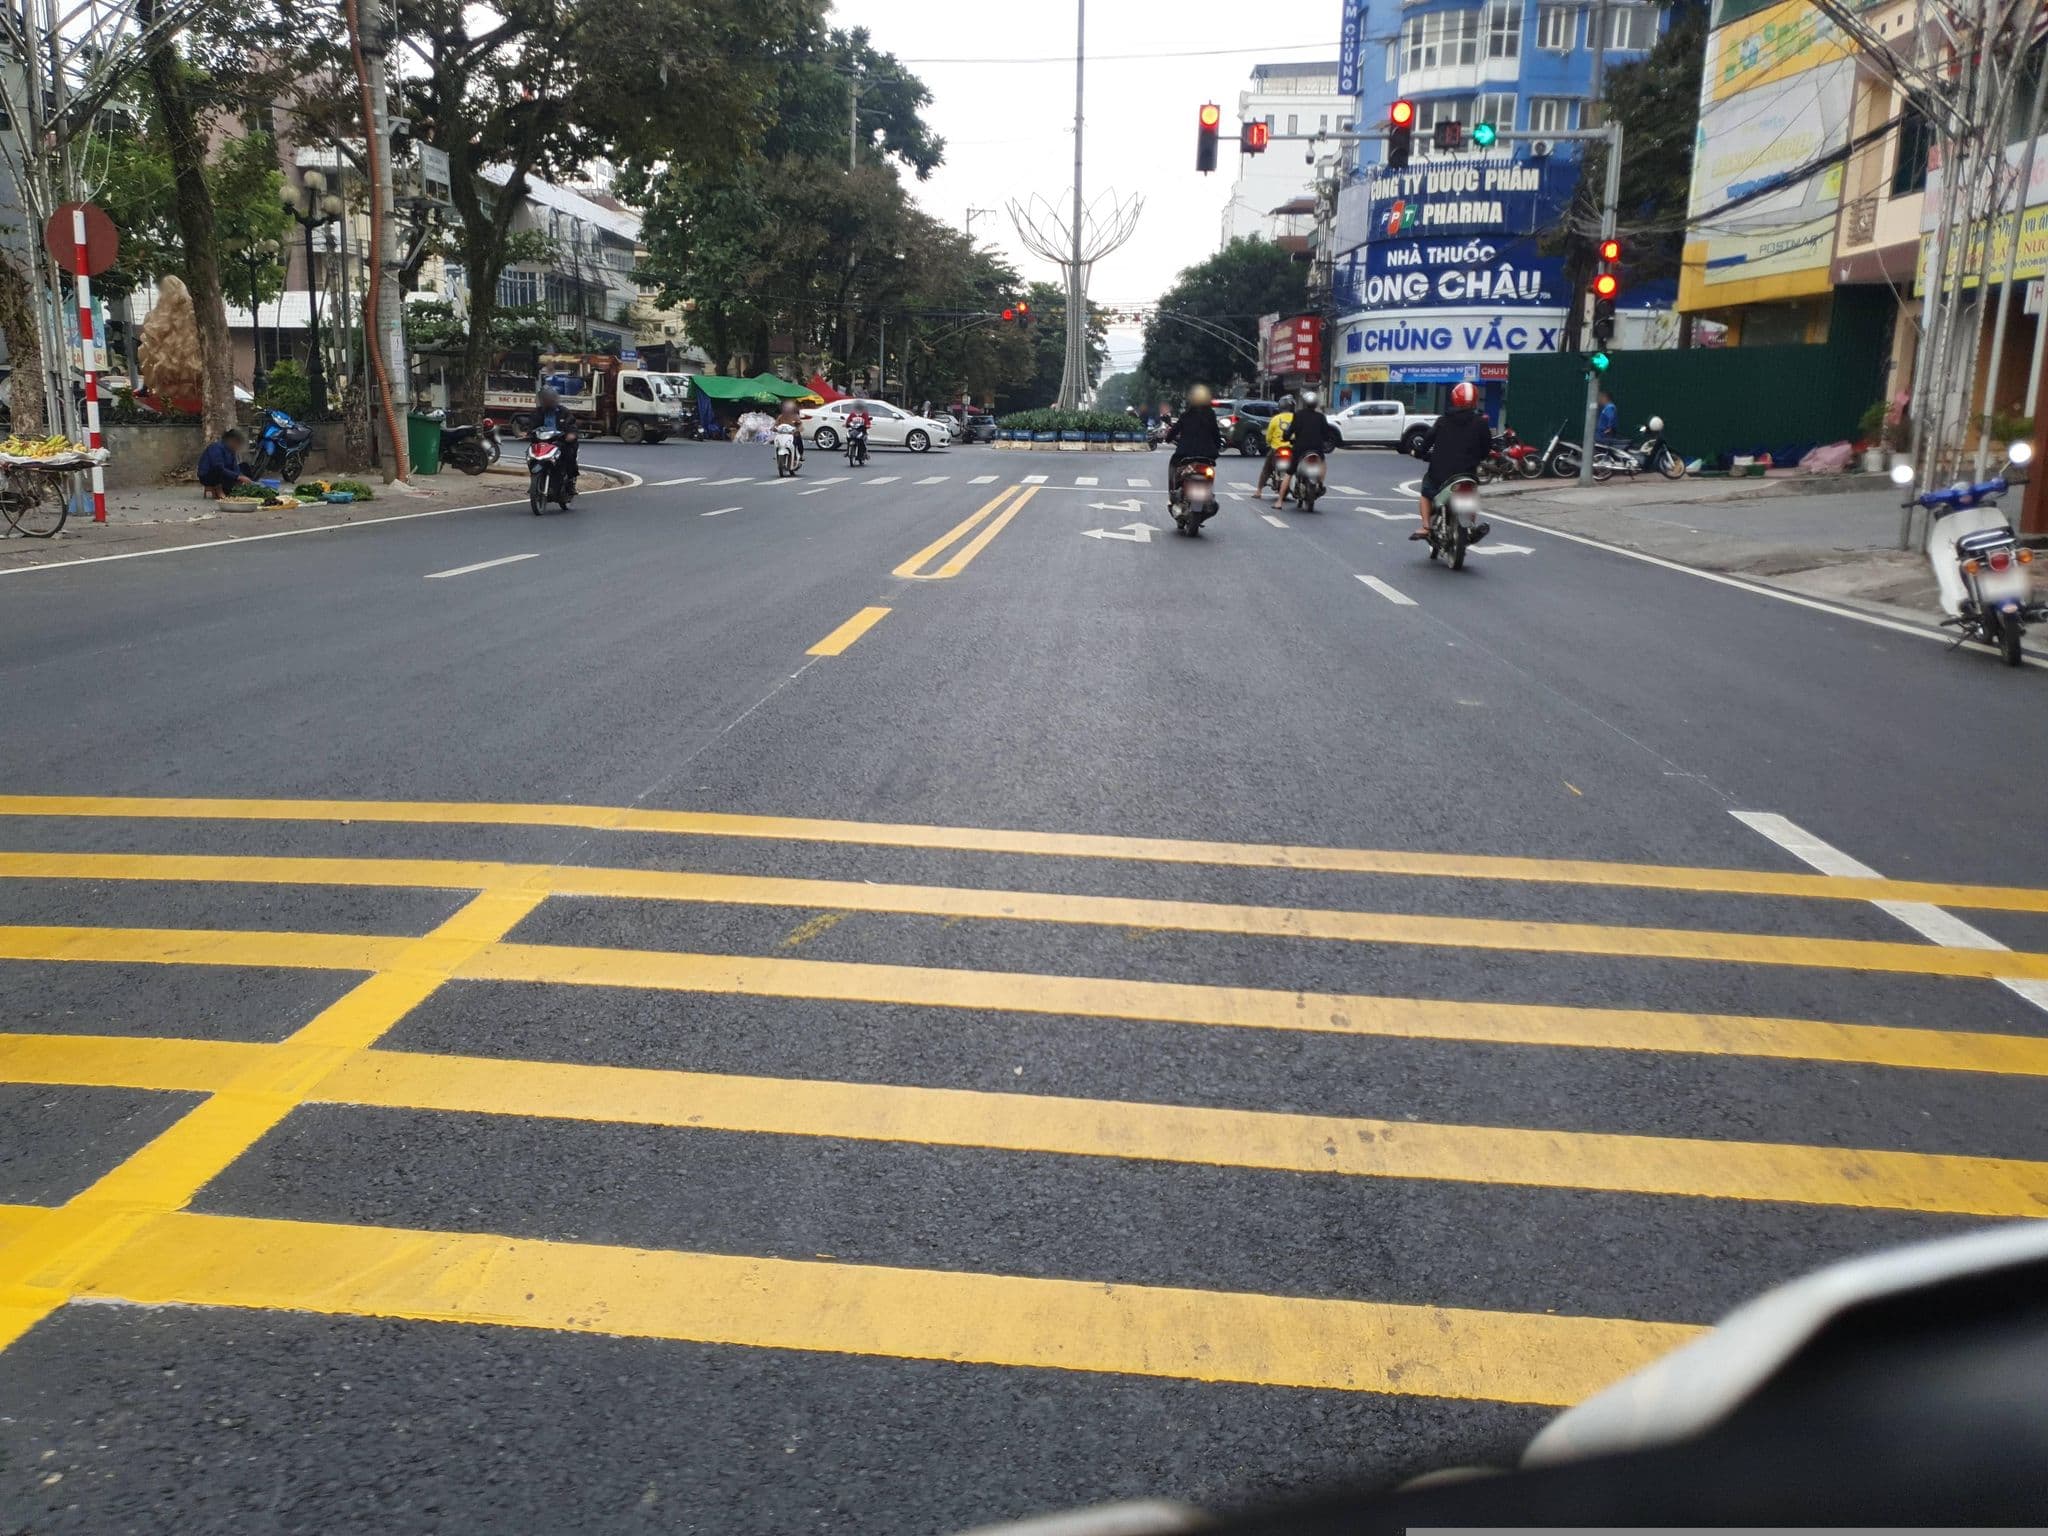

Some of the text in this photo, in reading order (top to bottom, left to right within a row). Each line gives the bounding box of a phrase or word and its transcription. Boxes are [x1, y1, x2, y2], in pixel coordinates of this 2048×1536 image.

[1403, 175, 1422, 195] TY
[1381, 202, 1503, 230] FPT PHARMA
[1387, 238, 1497, 267] NHÀ THUỐC
[1437, 262, 1542, 300] CHÂU
[1364, 320, 1453, 351] CHỦNG
[1463, 315, 1528, 351] VẮC
